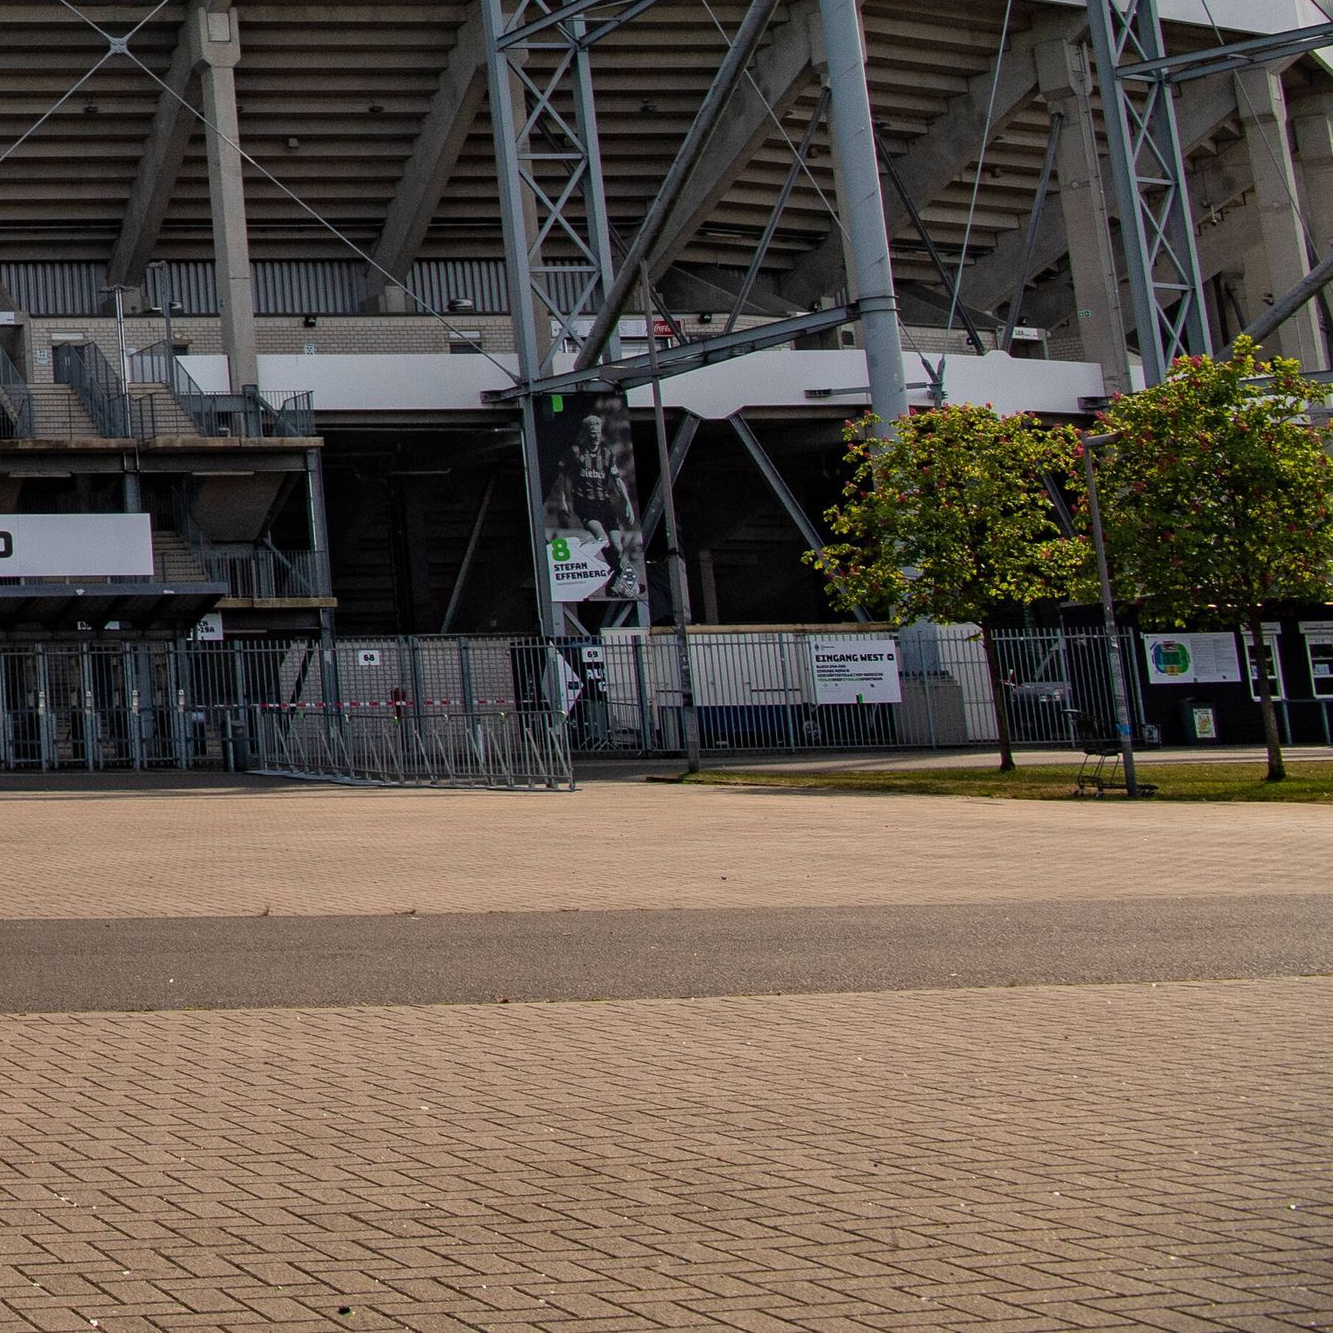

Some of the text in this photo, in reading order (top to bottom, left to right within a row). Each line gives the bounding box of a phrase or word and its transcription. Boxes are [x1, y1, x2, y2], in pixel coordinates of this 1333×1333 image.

[551, 538, 571, 562] 8
[554, 562, 588, 572] STEFAN
[555, 569, 607, 581] EFFENBERG
[587, 650, 598, 658] 69
[815, 653, 884, 663] EINGANG WEST
